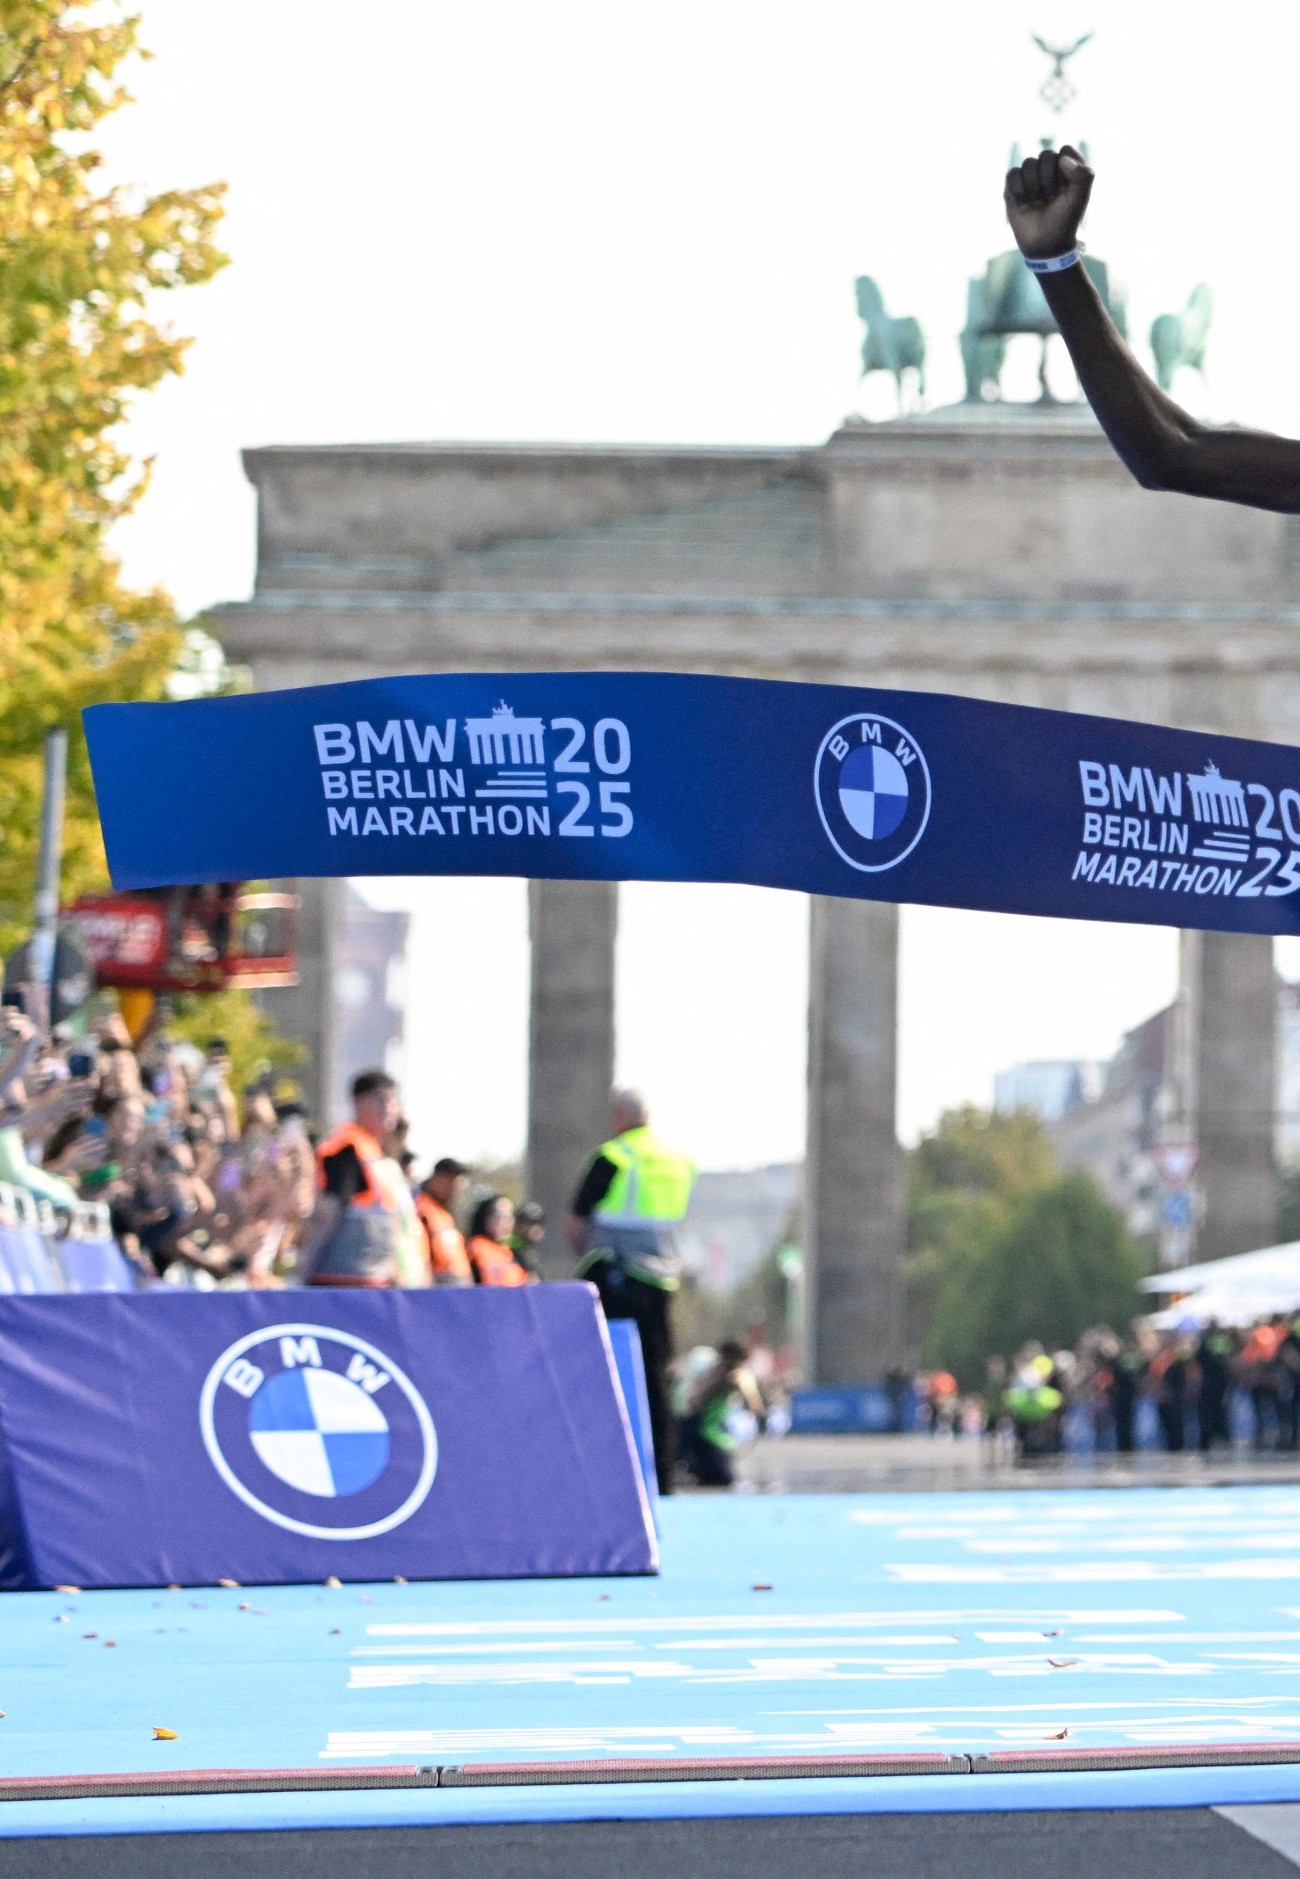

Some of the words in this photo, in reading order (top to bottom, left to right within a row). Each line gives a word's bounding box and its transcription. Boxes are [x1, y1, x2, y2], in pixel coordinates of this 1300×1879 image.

[313, 718, 457, 765] BMW
[551, 717, 631, 775] 20
[828, 722, 917, 767] BMW
[321, 769, 466, 799] BERLIN
[1079, 760, 1182, 817] BMW
[327, 804, 550, 836] MARATHON
[556, 781, 634, 838] 25
[1083, 812, 1189, 855] BERLIN
[1071, 851, 1242, 896] MARATHON
[223, 1336, 392, 1398] BMW
